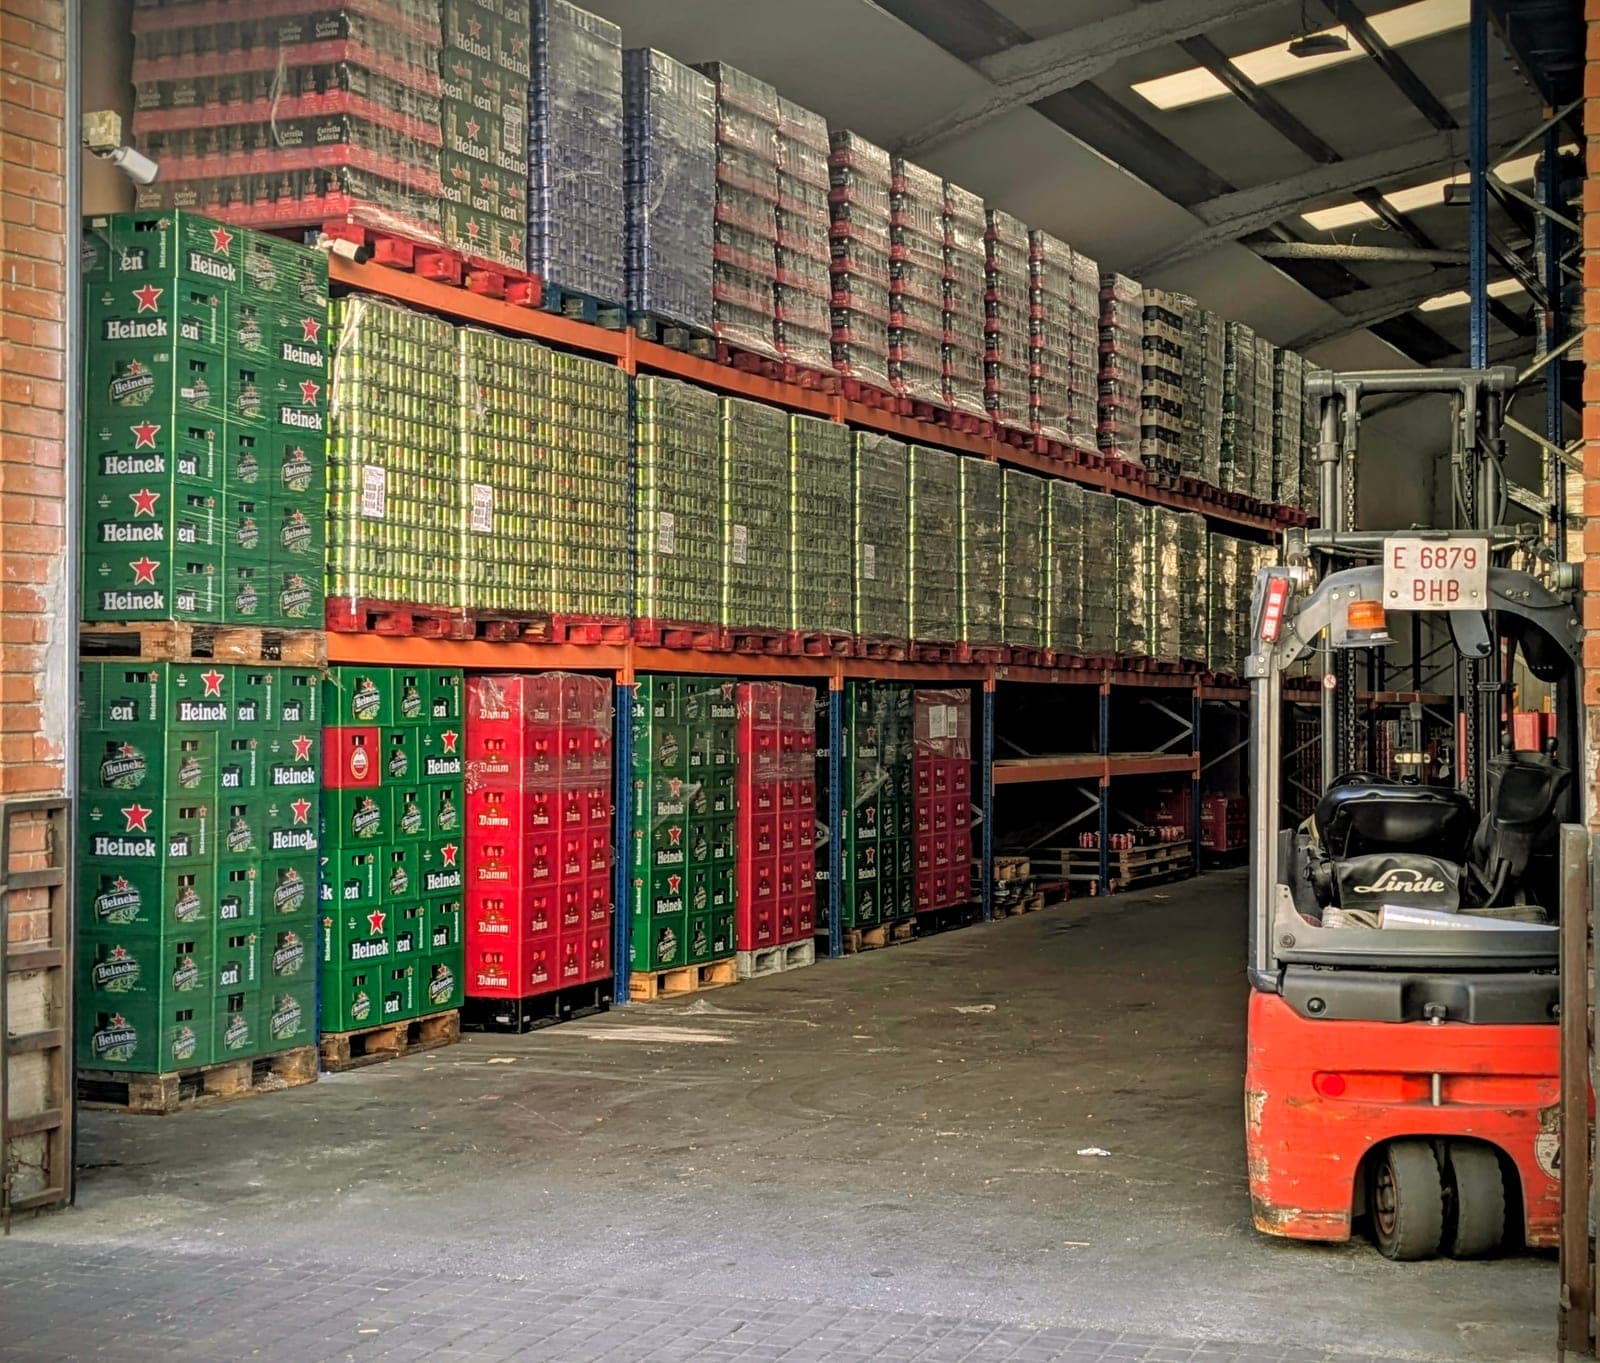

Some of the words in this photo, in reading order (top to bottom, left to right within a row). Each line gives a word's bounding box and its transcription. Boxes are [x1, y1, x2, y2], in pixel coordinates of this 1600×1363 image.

[190, 252, 236, 281] Heinek
[107, 319, 168, 339] Heinek
[283, 343, 323, 367] Heinek
[281, 407, 323, 430] Heinek
[105, 454, 165, 474] Heinek
[104, 523, 164, 542] Heinek
[1394, 546, 1406, 569] E
[1420, 546, 1477, 570] 6879
[1413, 579, 1460, 602] BHB
[104, 593, 164, 610] Heinek
[180, 703, 227, 720] Heinek
[428, 759, 460, 774] Heinek
[480, 763, 508, 772] Damm
[274, 768, 314, 784] Heinek
[479, 815, 508, 826] Damm
[96, 838, 156, 856] Heinek
[428, 872, 460, 890] Heinek
[478, 869, 508, 880] Damm
[1353, 868, 1445, 893] Linde
[478, 922, 508, 932] Damm
[352, 940, 388, 959] Heinek
[478, 976, 508, 986] Damm
